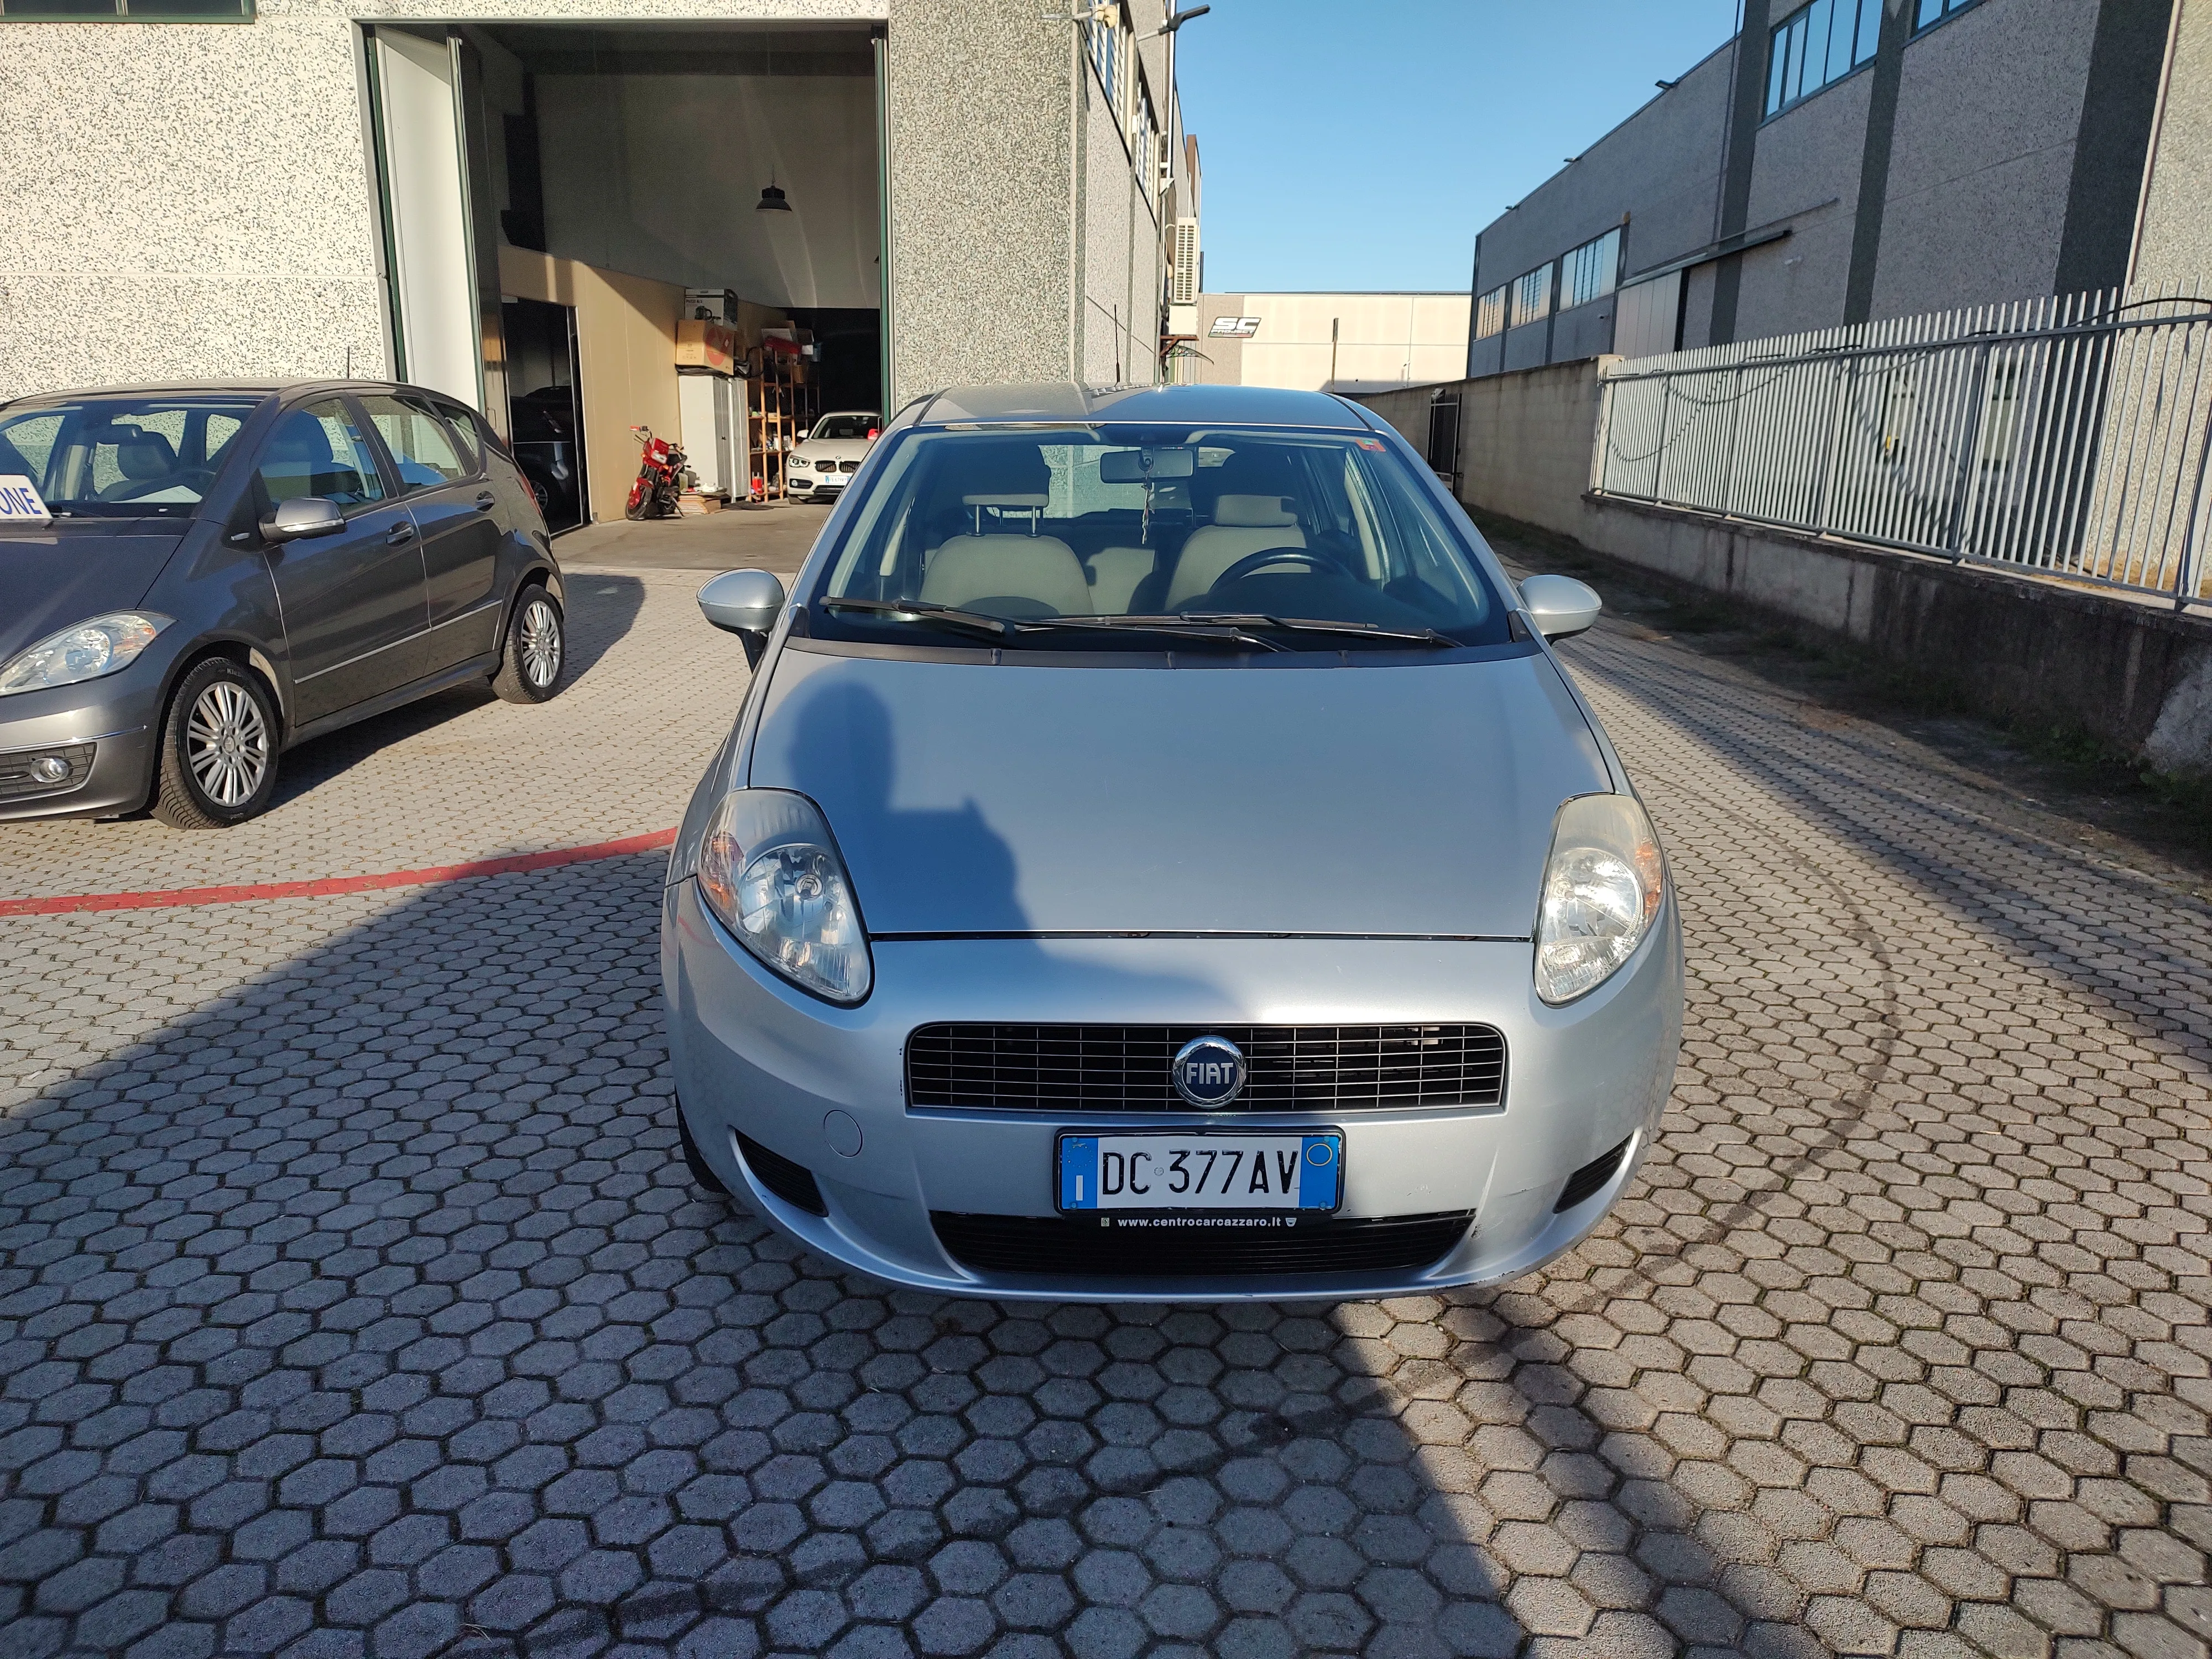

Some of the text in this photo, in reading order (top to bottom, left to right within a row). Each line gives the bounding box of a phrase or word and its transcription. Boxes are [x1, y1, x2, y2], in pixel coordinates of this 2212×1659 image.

[1212, 317, 1260, 330] SC
[1186, 1063, 1233, 1084] FIAT
[1103, 1150, 1152, 1194] DC
[1168, 1150, 1298, 1194] 377AV
[1117, 1217, 1281, 1227] www.centrocarcazzaro.it
